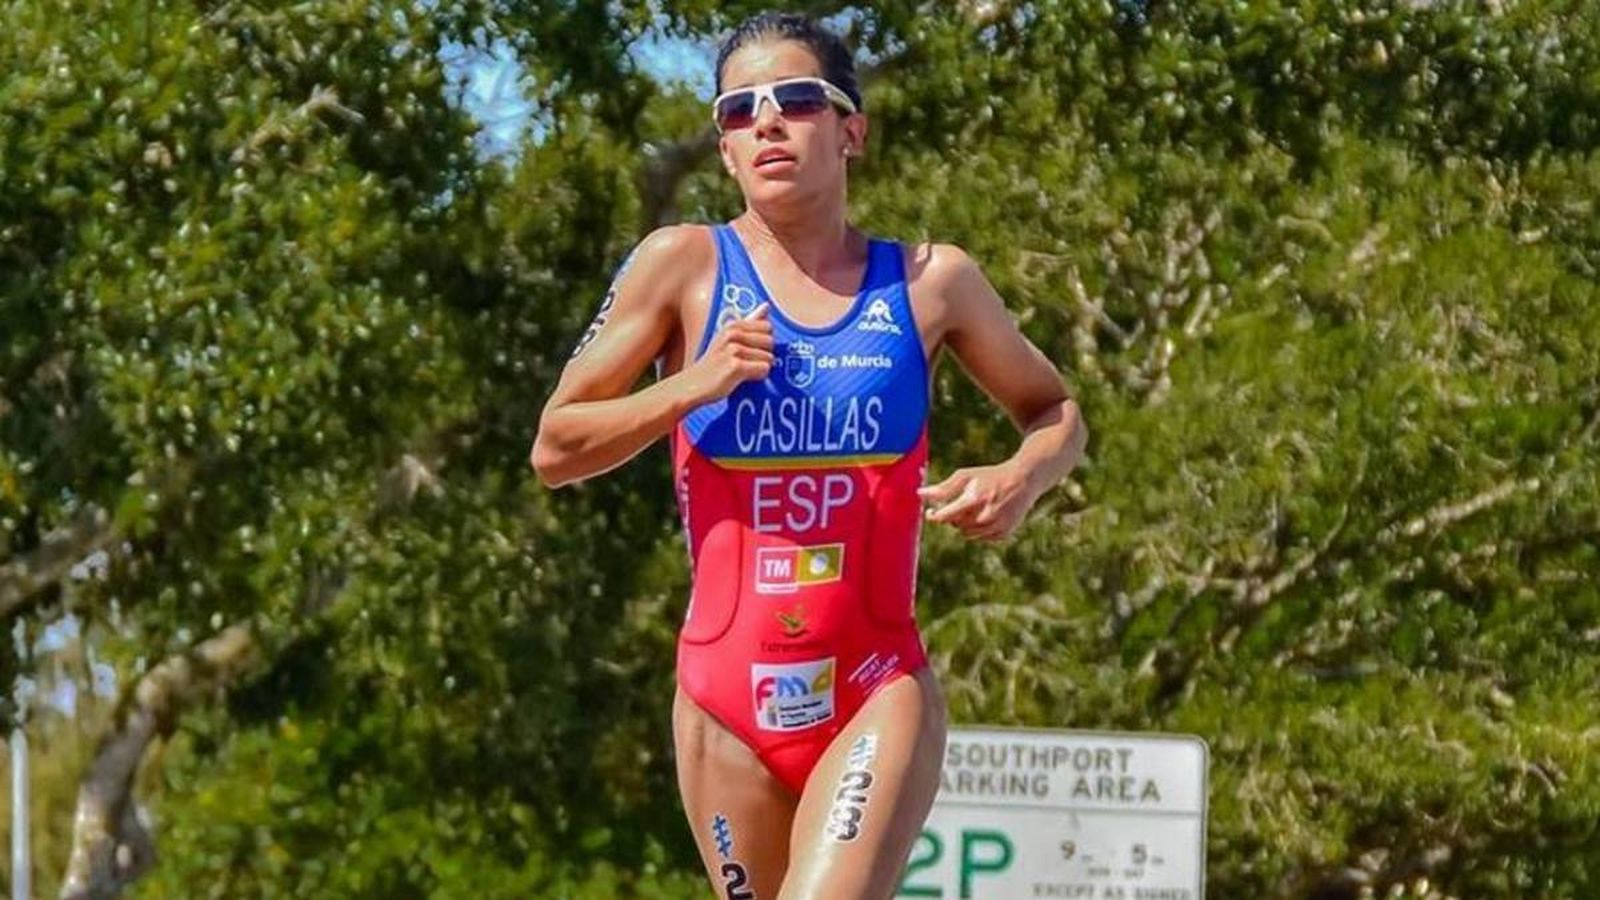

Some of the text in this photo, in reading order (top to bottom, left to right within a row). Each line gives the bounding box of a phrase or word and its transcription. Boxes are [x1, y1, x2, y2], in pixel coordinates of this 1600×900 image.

[817, 354, 892, 369] de Murcia
[735, 396, 883, 453] CASILLAS
[753, 474, 854, 533] ESP
[763, 559, 791, 577] TM
[947, 743, 1133, 772] SOUTHPORT
[940, 770, 1161, 802] ARKING AREA
[894, 827, 1014, 900] 2P
[1061, 841, 1076, 860] 9
[1132, 844, 1147, 864] 5
